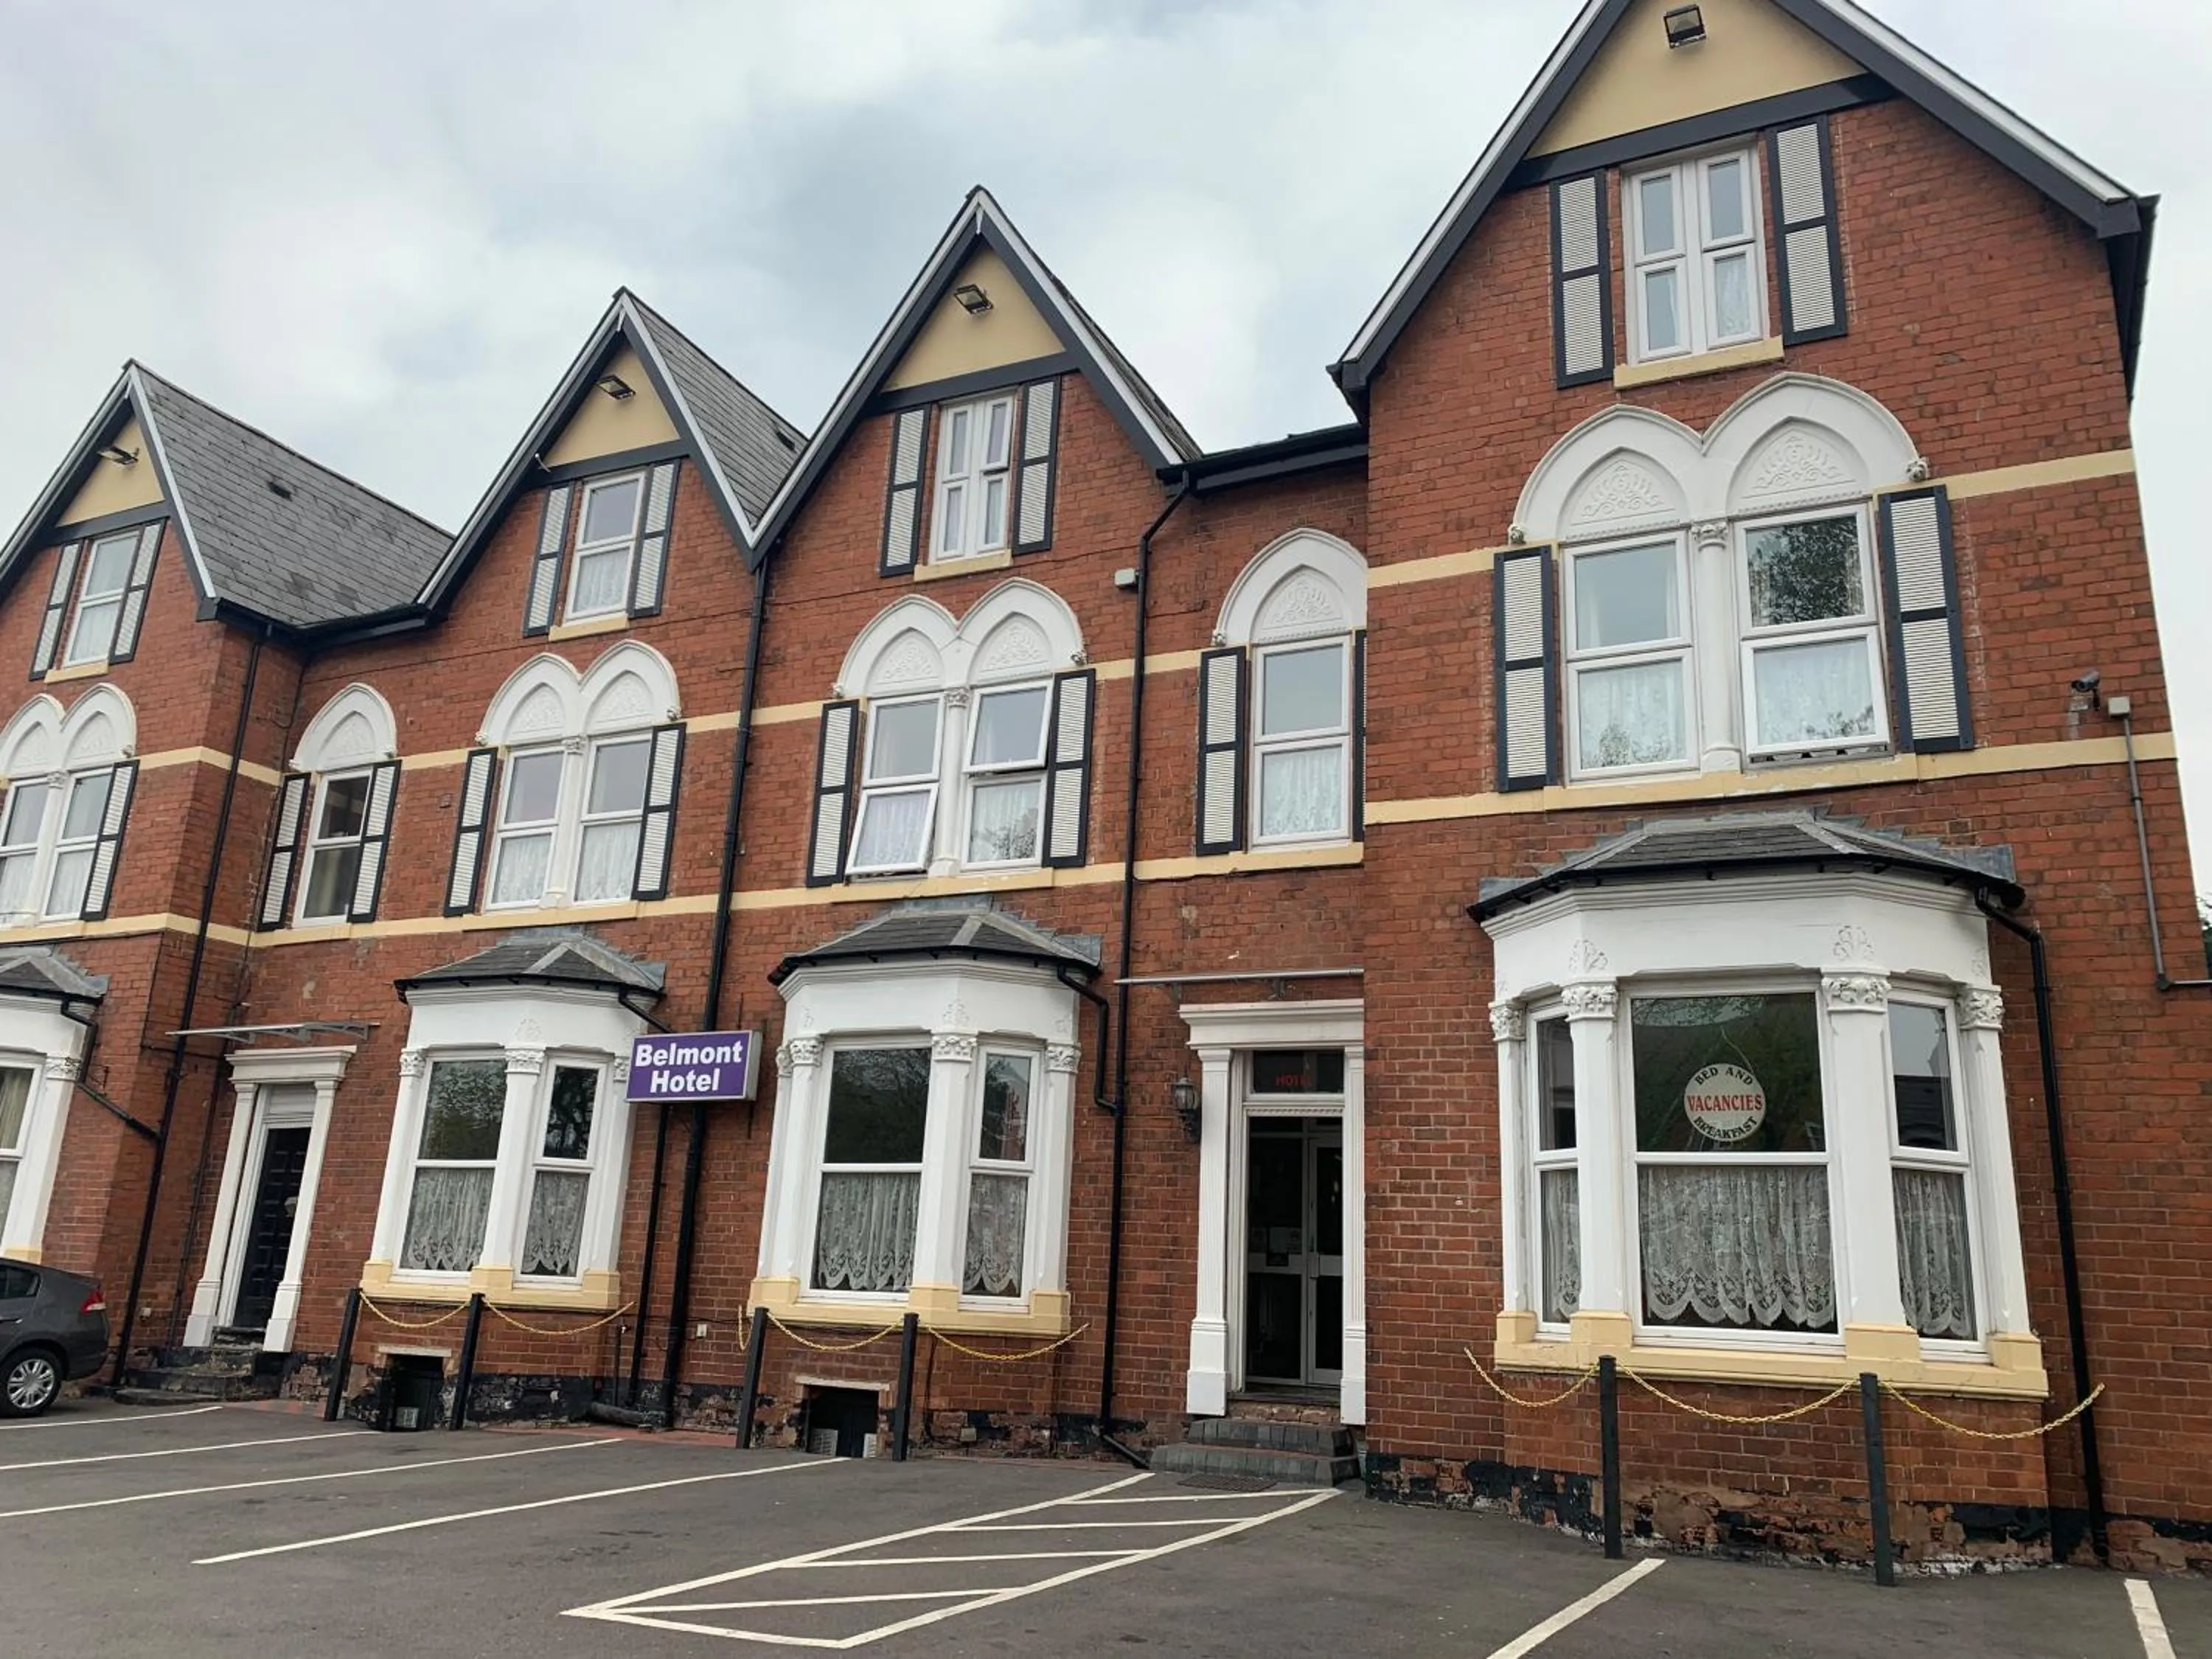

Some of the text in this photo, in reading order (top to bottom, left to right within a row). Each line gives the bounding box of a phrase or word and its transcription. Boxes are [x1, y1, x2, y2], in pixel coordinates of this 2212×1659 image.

[635, 1040, 743, 1067] Belmont
[650, 1068, 720, 1093] Hotel
[1694, 1066, 1753, 1085] BED AND
[1686, 1094, 1763, 1111] VACANCIES
[1694, 1116, 1758, 1138] BREAKFAST
